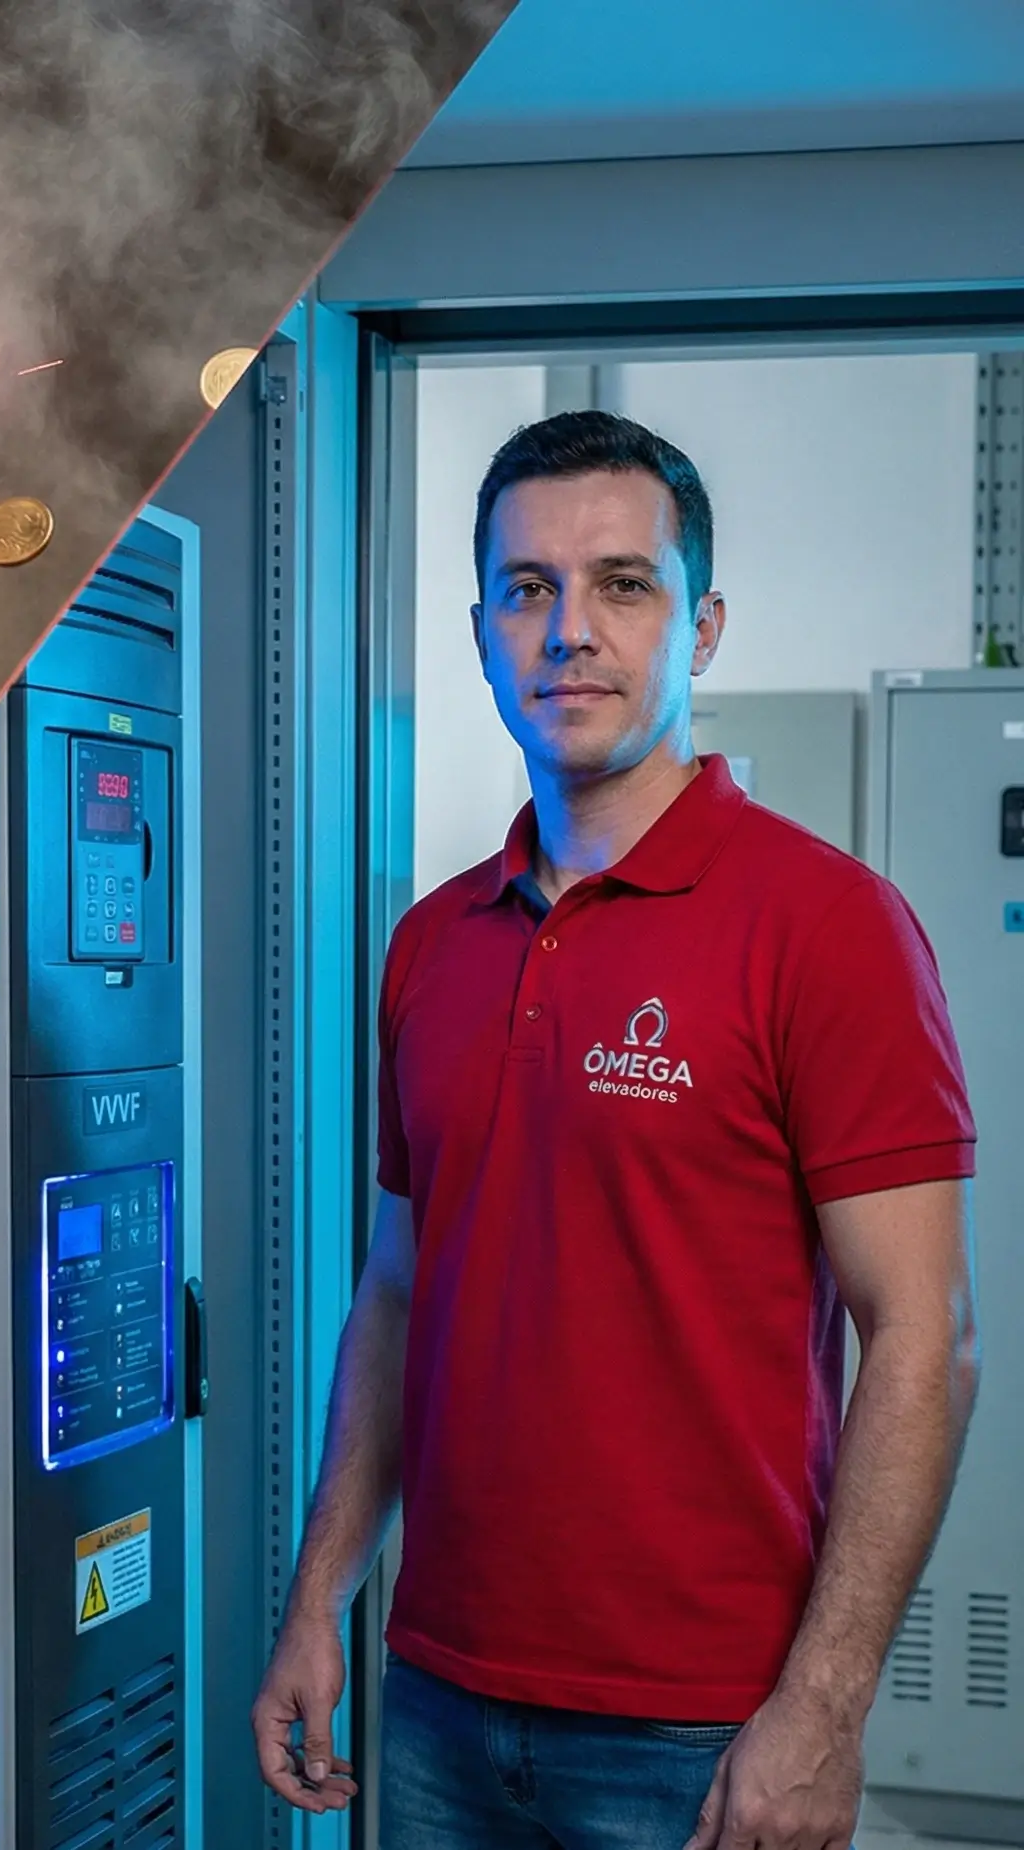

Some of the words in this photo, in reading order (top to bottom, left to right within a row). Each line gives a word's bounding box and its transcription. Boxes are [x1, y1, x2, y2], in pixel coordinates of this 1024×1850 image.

[583, 1042, 694, 1088] ÔMEGA
[588, 1078, 679, 1104] elevadores
[92, 1092, 141, 1126] VVVF
